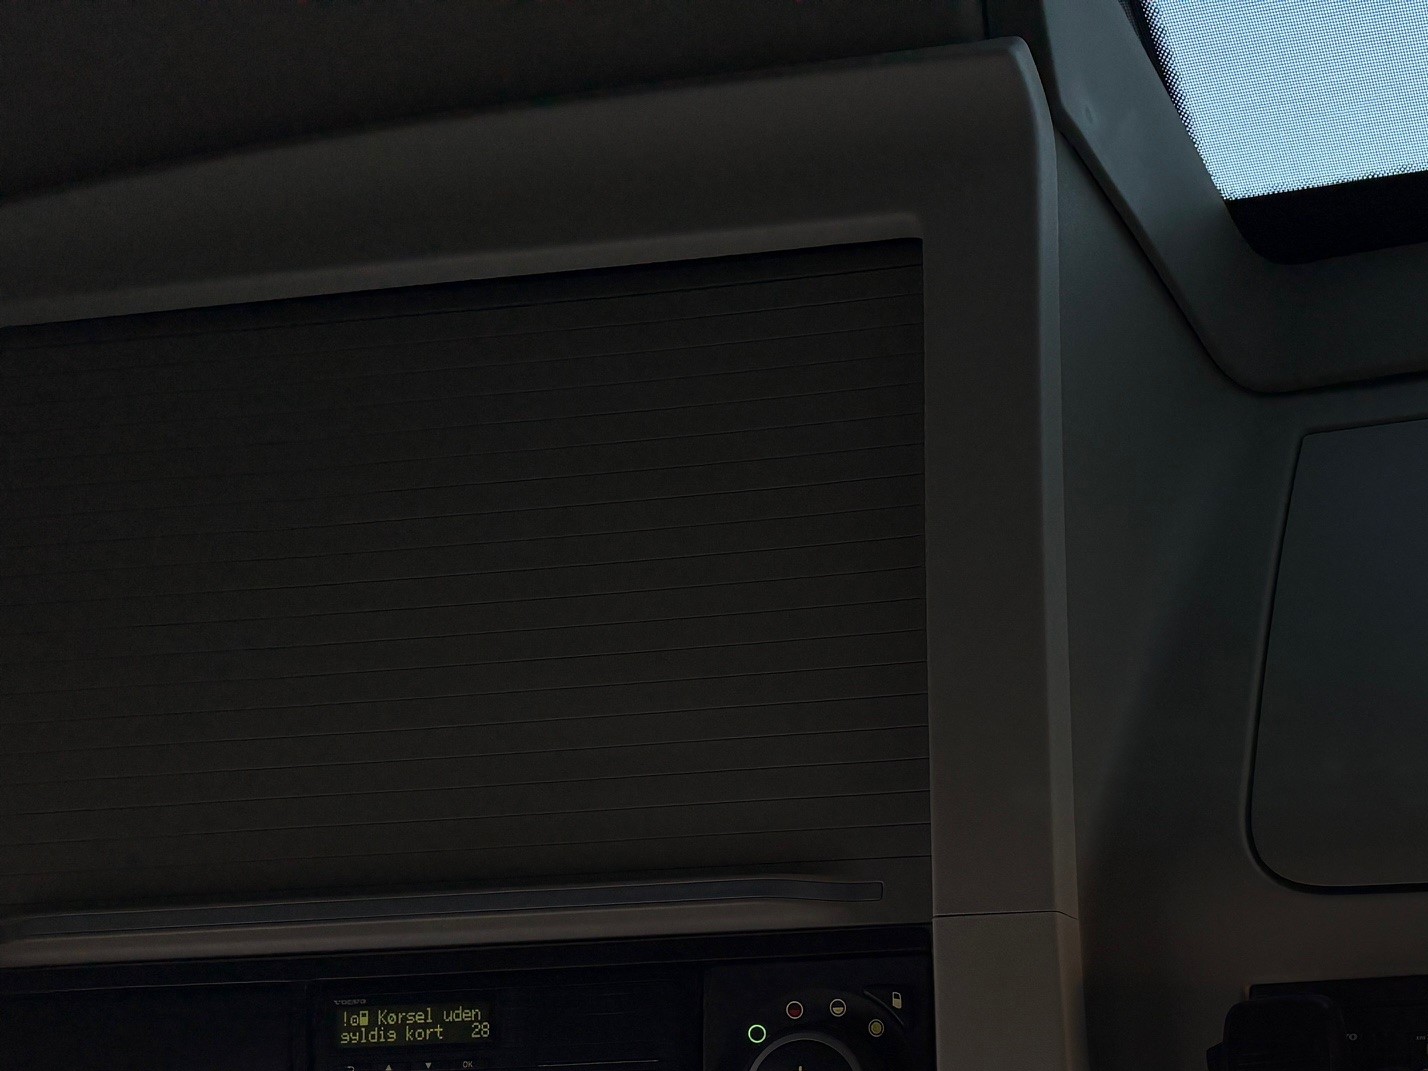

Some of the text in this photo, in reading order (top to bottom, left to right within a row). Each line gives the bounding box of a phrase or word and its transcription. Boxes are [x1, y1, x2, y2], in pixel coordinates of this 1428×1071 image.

[443, 1005, 481, 1022] uden
[405, 1024, 444, 1041] kort
[471, 1022, 491, 1038] 28
[463, 1060, 473, 1068] OK
